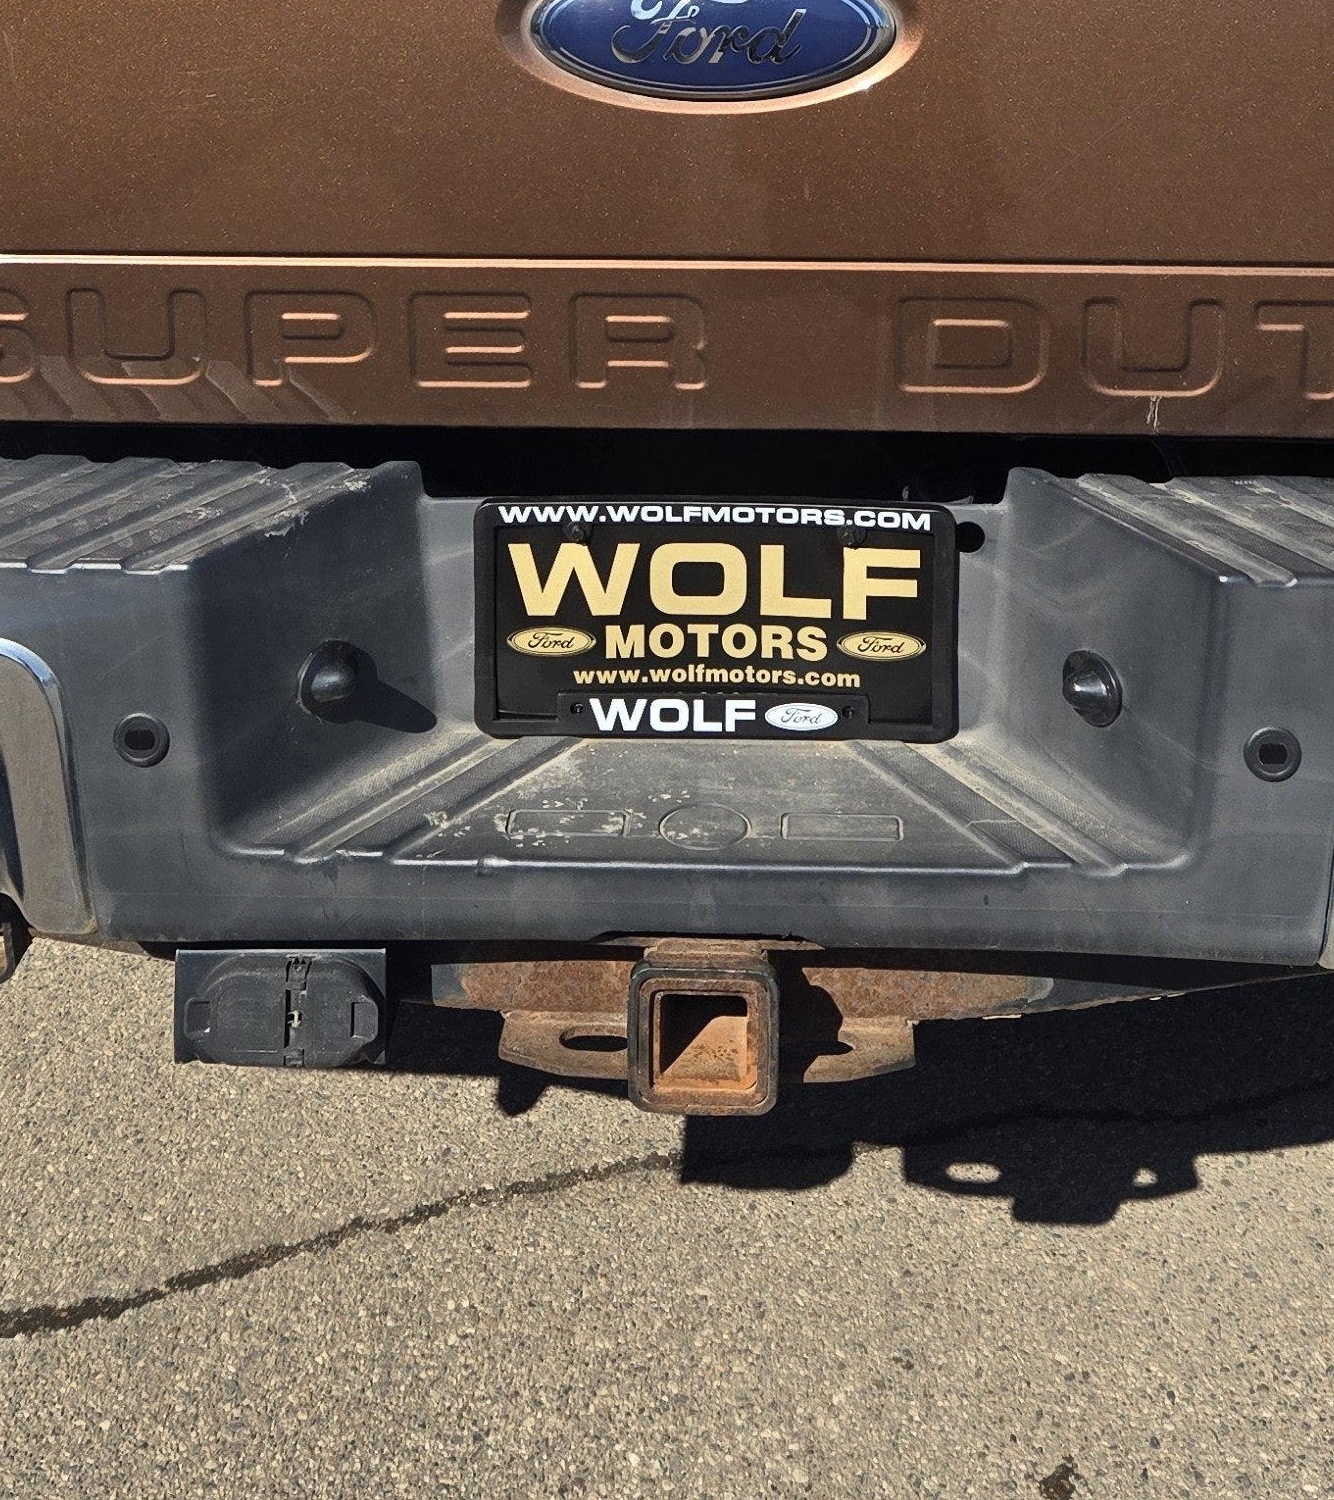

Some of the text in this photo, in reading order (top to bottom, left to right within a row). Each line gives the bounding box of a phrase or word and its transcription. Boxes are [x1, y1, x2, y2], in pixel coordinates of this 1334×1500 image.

[497, 505, 931, 532] WWW.WOLFMOTORS.COM
[507, 542, 921, 621] WOLF
[604, 623, 829, 662] MOTORS
[573, 663, 861, 688] www.wolfmotors.com
[588, 698, 757, 733] WOLF
